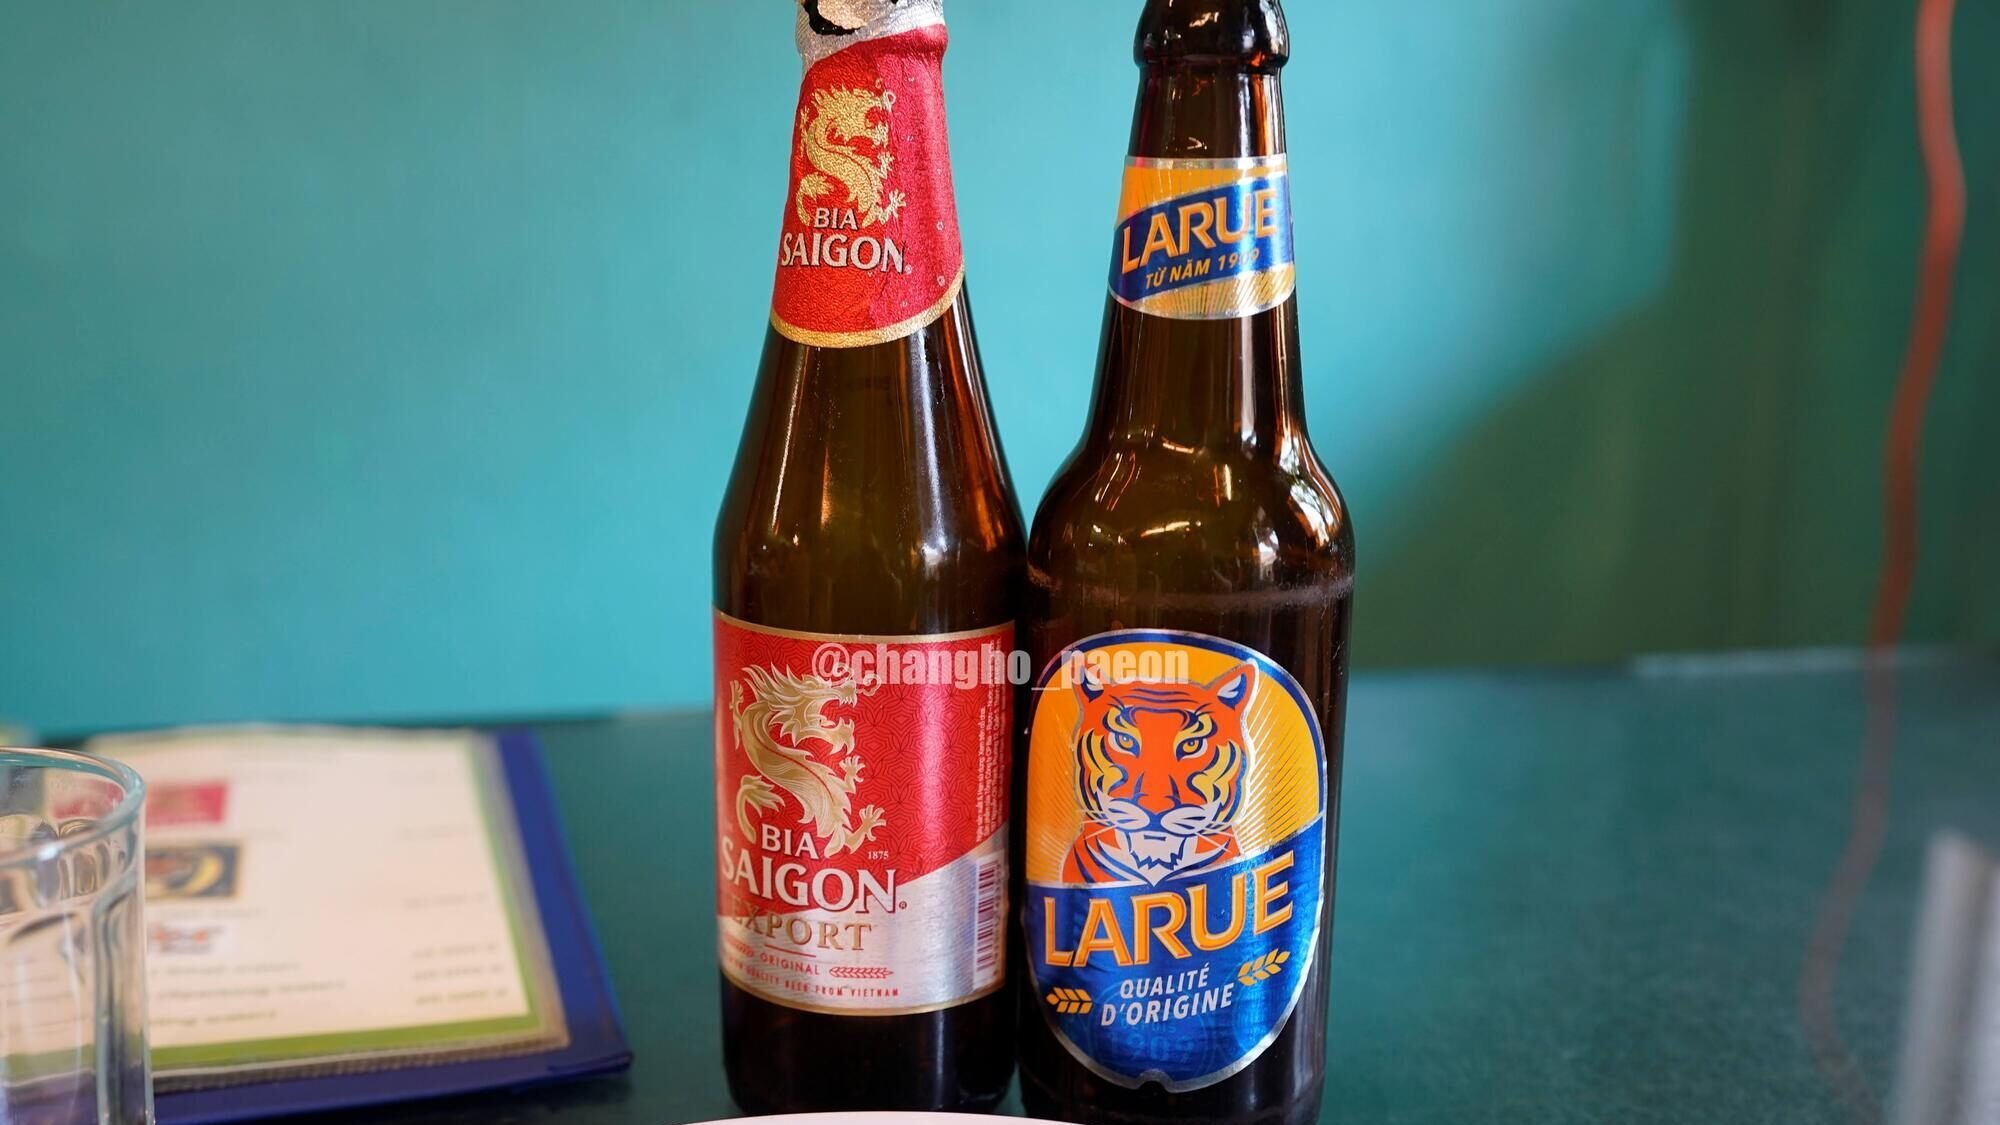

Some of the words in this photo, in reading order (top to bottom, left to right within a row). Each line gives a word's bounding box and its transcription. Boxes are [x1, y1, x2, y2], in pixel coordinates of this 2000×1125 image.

[814, 207, 858, 230] BIA
[1122, 188, 1278, 274] LARUE
[781, 232, 904, 274] SAIGON
[1169, 258, 1211, 283] NĂM
[761, 823, 820, 860] BIA
[867, 851, 889, 860] 1875
[721, 836, 897, 914] SAIGON
[731, 895, 872, 951] EXPORT
[1043, 849, 1295, 968] LARUE
[760, 952, 820, 976] ORIGINAL
[1119, 962, 1211, 999] QUALITÉ
[815, 985, 843, 997] FROM
[851, 988, 900, 998] VIETNAM
[1100, 983, 1235, 1027] D'ORIGINE
